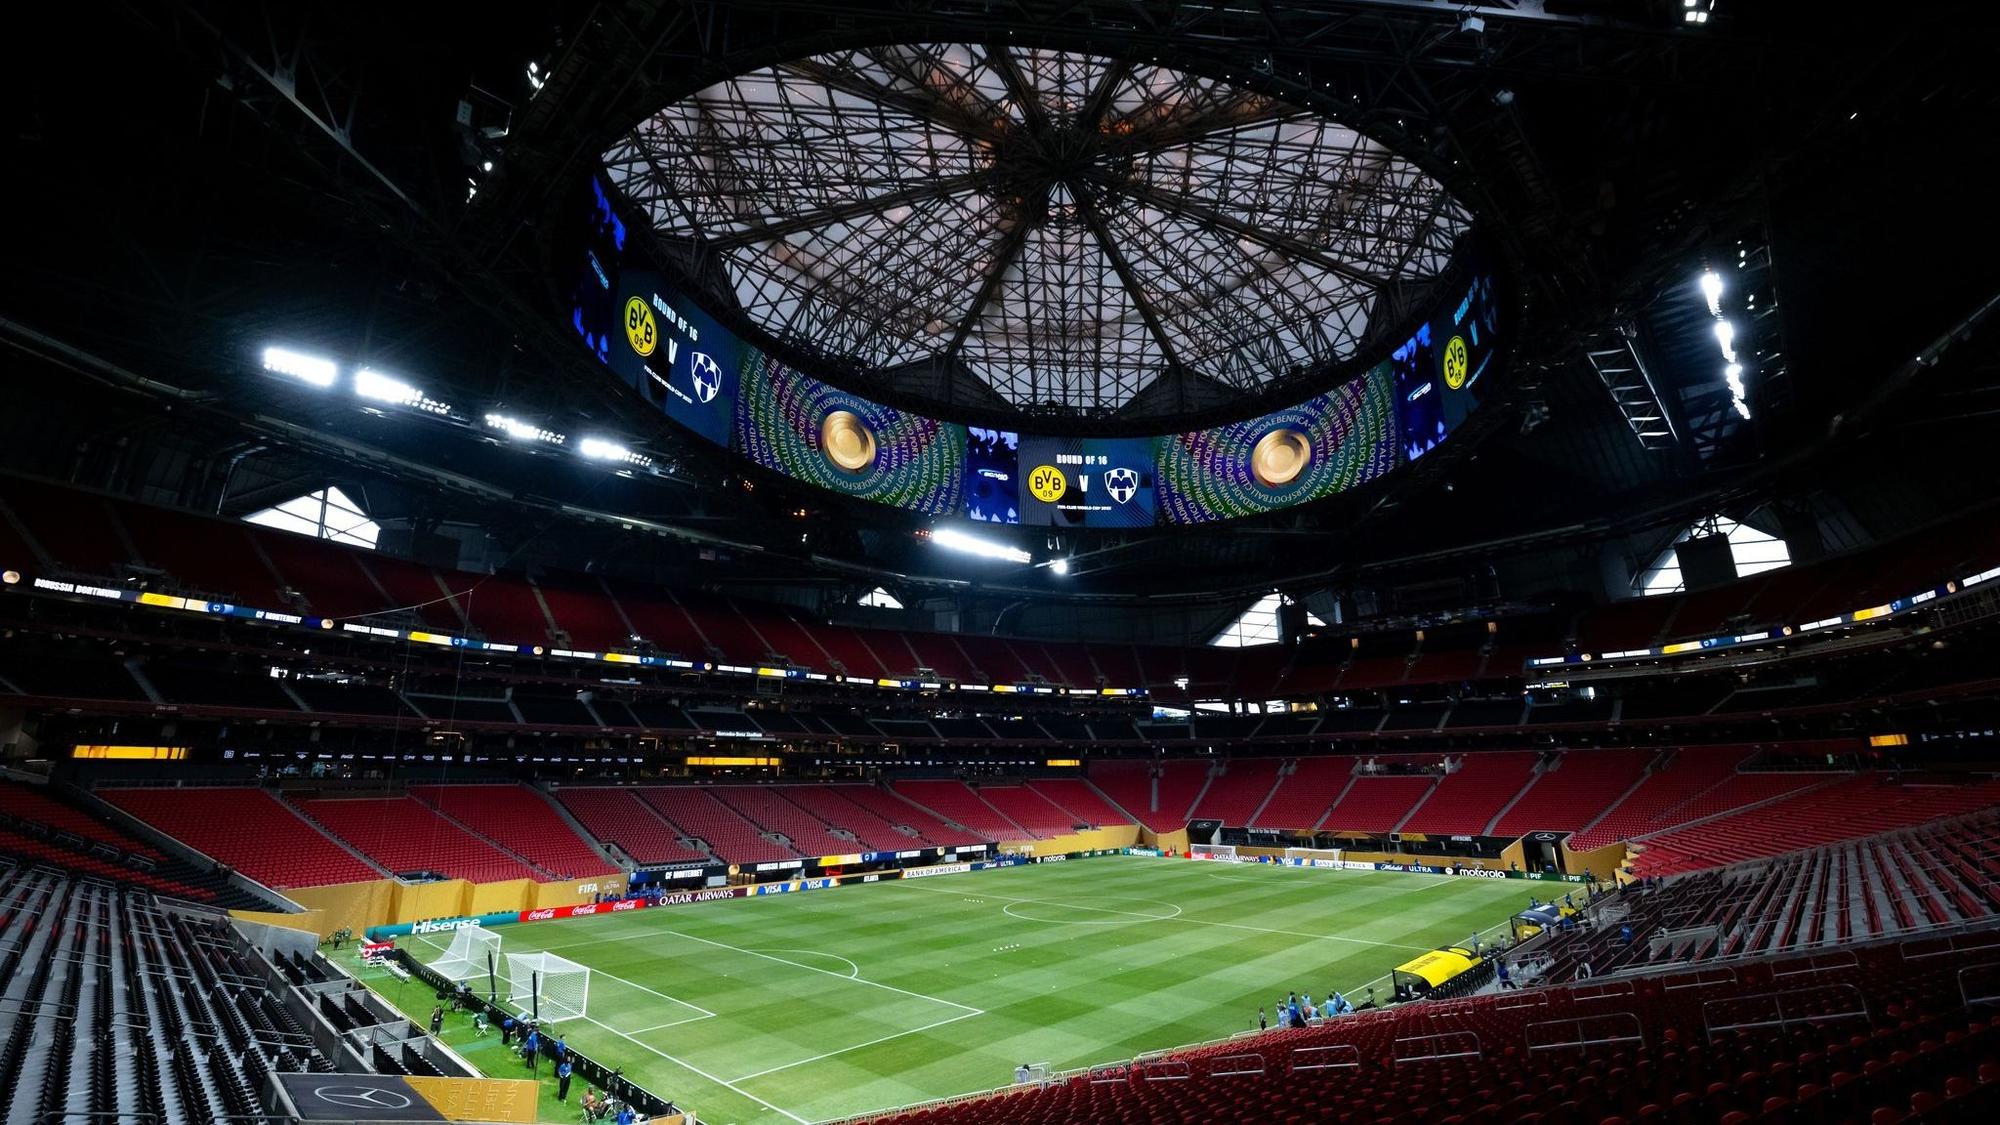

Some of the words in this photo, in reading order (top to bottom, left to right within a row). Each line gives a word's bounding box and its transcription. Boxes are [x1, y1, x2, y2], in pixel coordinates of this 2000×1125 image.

[629, 303, 653, 345] BVB
[653, 292, 676, 324] ROUND
[678, 316, 688, 333] OF
[689, 326, 698, 342] 16
[634, 333, 644, 349] 09
[668, 337, 678, 365] V
[1447, 341, 1465, 378] BVB
[759, 411, 767, 438] RIVER
[766, 358, 780, 379] CLUB
[1359, 387, 1370, 404] LOS
[808, 405, 824, 430] SPORT
[1276, 413, 1309, 428] BENFICA
[1323, 403, 1346, 446] JUVENTUS
[1342, 408, 1355, 437] PORTO
[1354, 407, 1367, 446] REGATAS
[1364, 403, 1377, 443] ANGELES
[927, 430, 938, 447] LOS
[1184, 431, 1197, 451] CLUB
[1308, 423, 1325, 458] SEATTLE
[1378, 418, 1388, 443] CLUB
[769, 426, 781, 462] BAYERN
[808, 432, 820, 458] CLUB
[892, 421, 910, 465] JUVENTUS
[910, 436, 921, 465] PORTO
[781, 445, 792, 466] CLUB
[931, 449, 941, 481] ANGELES
[1056, 454, 1083, 465] ROUND
[1085, 455, 1096, 465] OF
[1097, 455, 1108, 466] 16
[1213, 438, 1229, 482] FOOTBALL
[1225, 441, 1238, 487] ESPORTIVA
[1236, 441, 1251, 469] SPORT
[942, 468, 951, 489] CLUB
[1169, 452, 1179, 494] AUCKLAND
[1180, 457, 1190, 480] PLATE
[1320, 461, 1334, 483] REAL
[1035, 470, 1061, 490] BVB
[1078, 475, 1089, 493] V
[1238, 471, 1253, 491] CLUB
[1042, 489, 1053, 498] 09
[1181, 480, 1193, 502] RIVER
[1195, 487, 1213, 516] BAYERN
[1208, 492, 1225, 511] CLUB
[34, 577, 75, 593] BORUSSIA
[74, 584, 122, 599] DORTMUND
[1129, 848, 1158, 857] Hisense
[665, 871, 672, 880] CF
[672, 869, 704, 880] MONTERREY
[906, 869, 926, 877] BANK
[934, 866, 962, 875] AMERICA
[1408, 865, 1433, 873] ULTRA
[1459, 866, 1506, 879] motorola
[578, 883, 598, 894] FIFA
[764, 884, 782, 894] VISA
[807, 880, 823, 890] VISA
[613, 899, 636, 912] Coca-Cola
[659, 894, 693, 906] QATAR
[695, 889, 734, 902] AIRWAYS
[528, 909, 556, 921] Coca-Cola
[572, 904, 596, 916] Coca-Cola
[411, 918, 481, 935] Hisense
